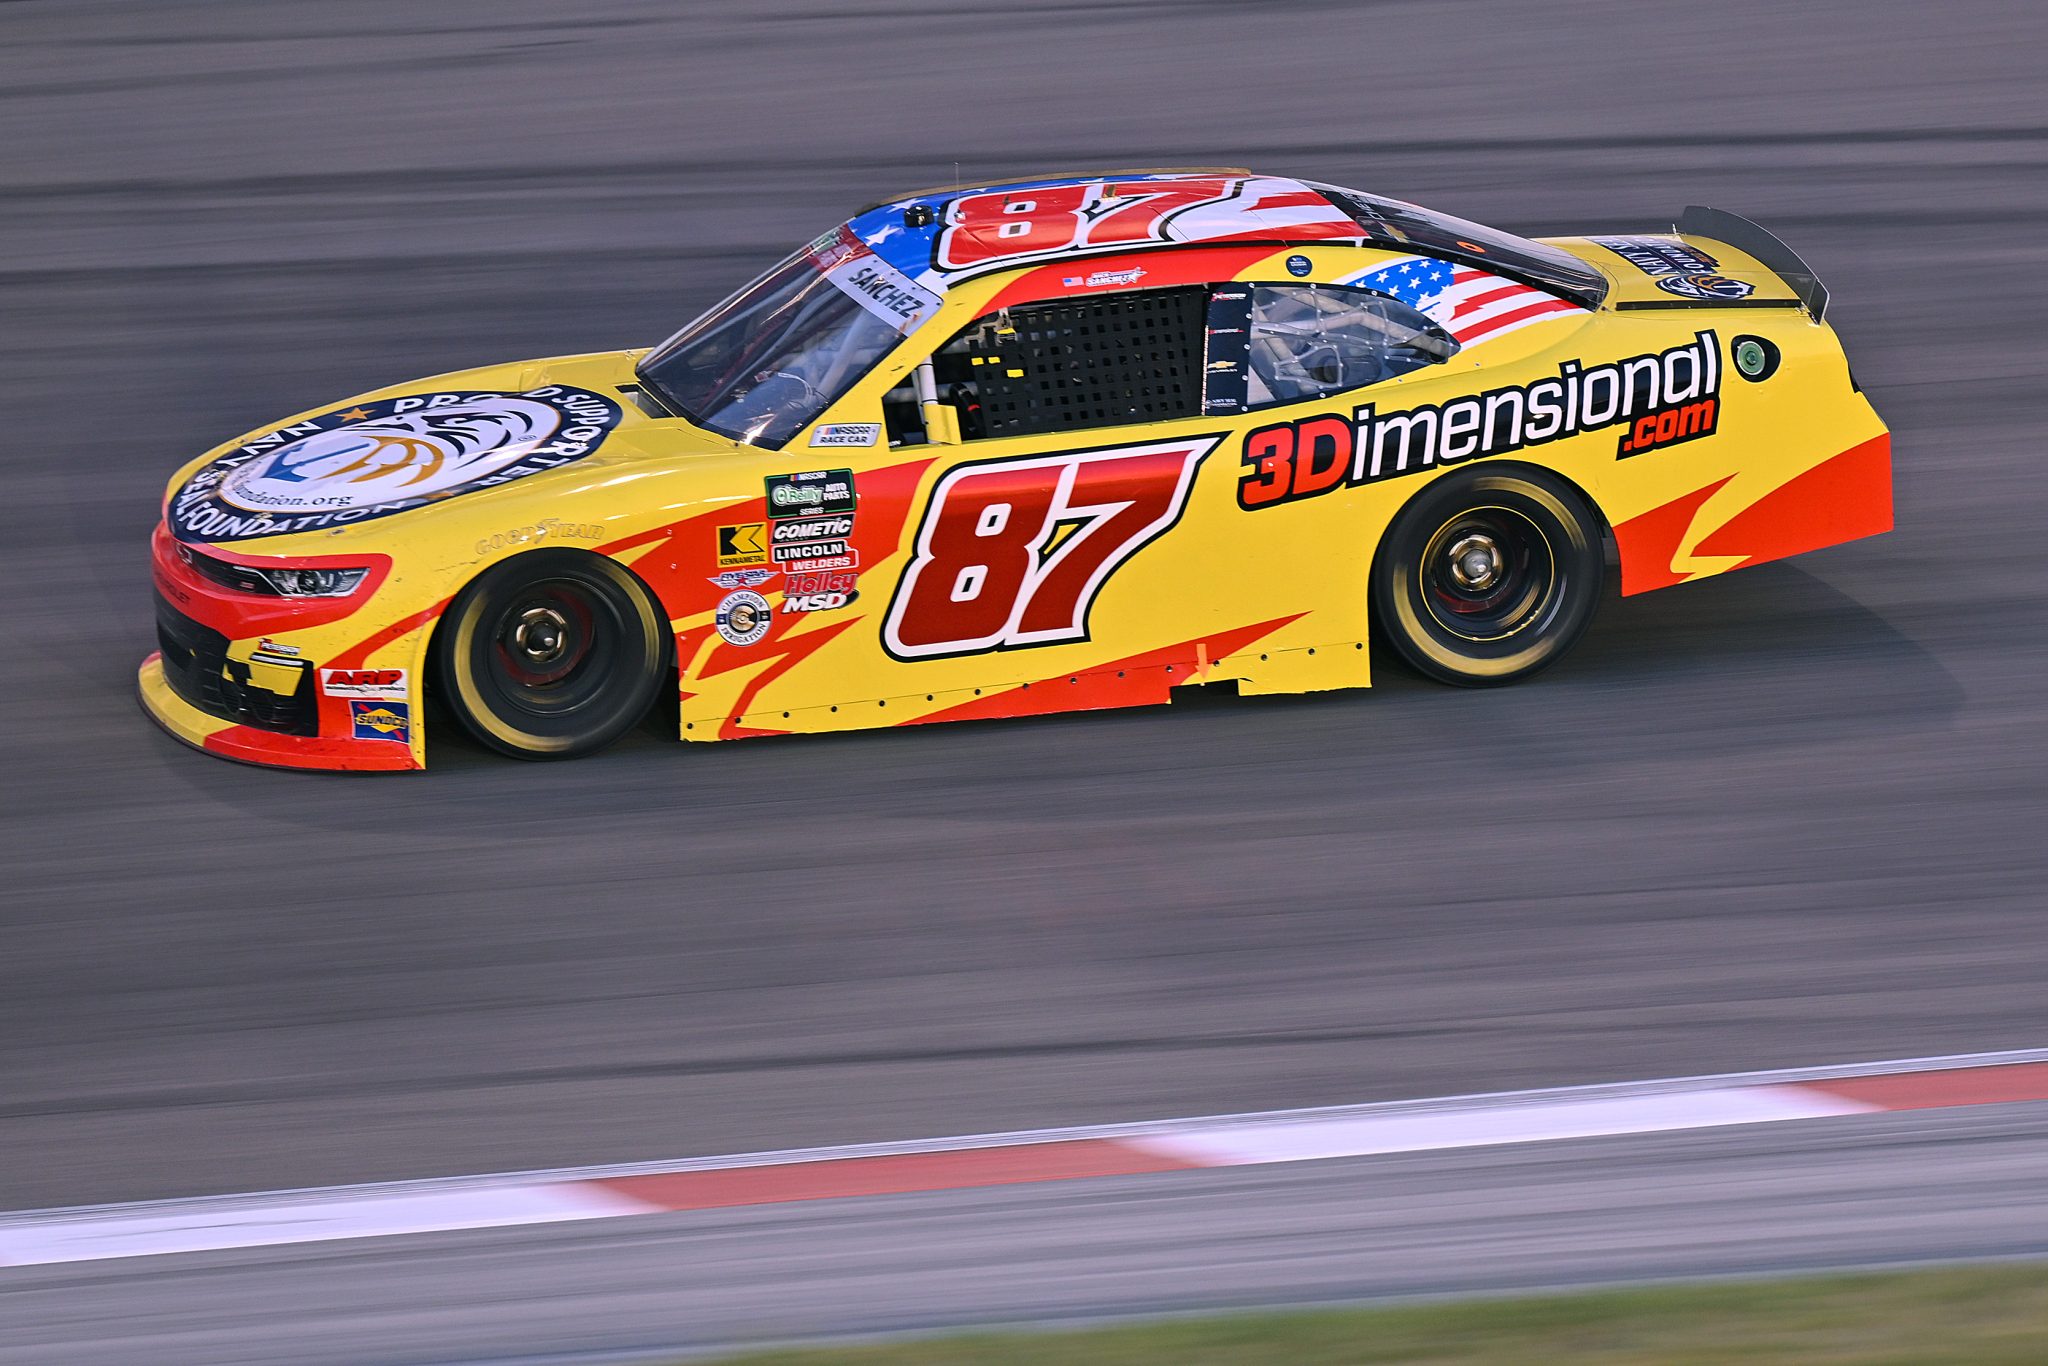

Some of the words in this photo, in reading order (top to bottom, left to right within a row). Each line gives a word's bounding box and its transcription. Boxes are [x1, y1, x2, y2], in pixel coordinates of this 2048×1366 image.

[931, 180, 1243, 272] 87
[848, 267, 926, 319] SANCHEZ
[1243, 332, 1717, 505] 3Dimensional
[1623, 399, 1715, 453] .com
[216, 420, 323, 468] NAVY
[474, 393, 611, 487] SUPPORTER
[823, 490, 851, 501] PARTS
[825, 482, 847, 492] AUTO
[177, 499, 407, 537] FOUNDATION
[475, 518, 607, 556] GOODYEAR
[774, 519, 852, 540] COMETIC
[776, 543, 843, 560] LINCOLN
[792, 557, 851, 571] WELDERS
[882, 434, 1226, 661] 87
[781, 592, 847, 614] MSD
[325, 669, 403, 686] ARP
[356, 713, 409, 728] SUNOCO
